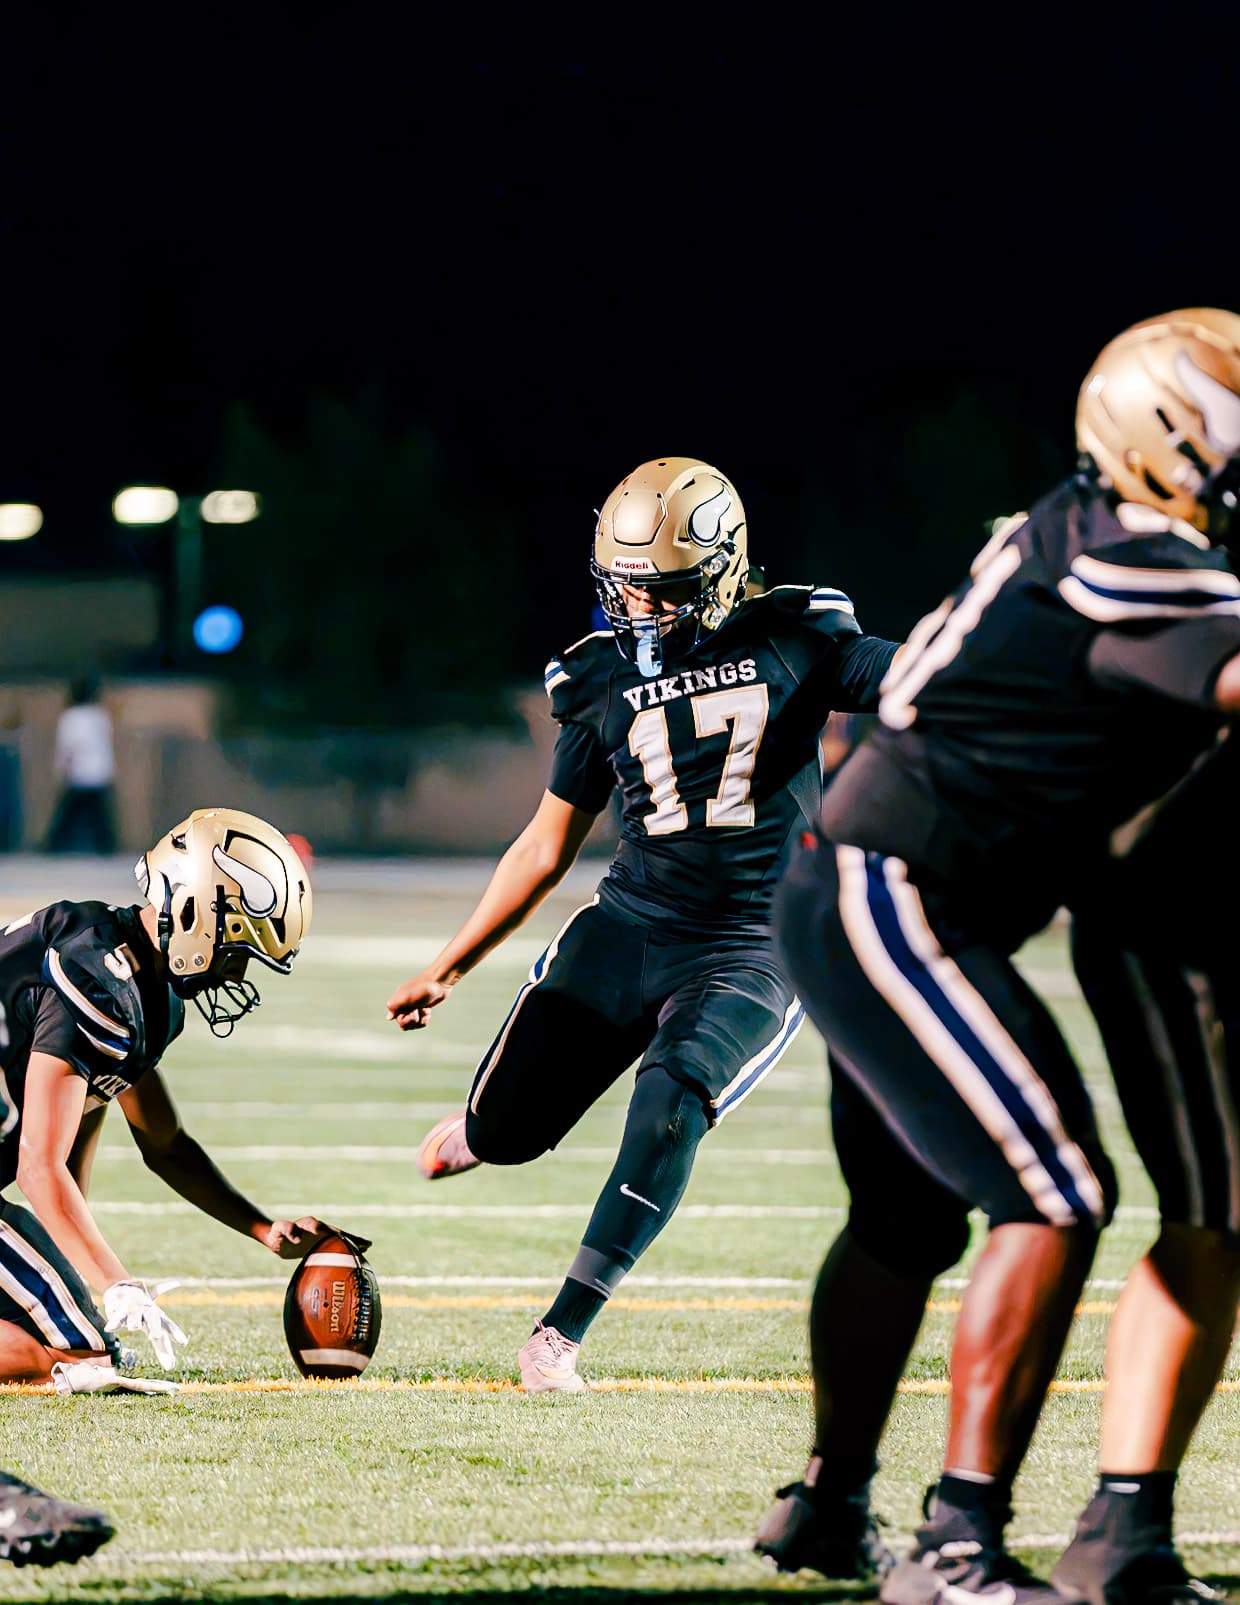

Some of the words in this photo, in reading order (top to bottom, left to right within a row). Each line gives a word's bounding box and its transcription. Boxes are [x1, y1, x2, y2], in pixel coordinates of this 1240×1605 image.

[615, 560, 649, 570] Riddell
[623, 658, 757, 712] VIKINGS
[627, 683, 769, 836] 17
[331, 1281, 346, 1333] Wilson
